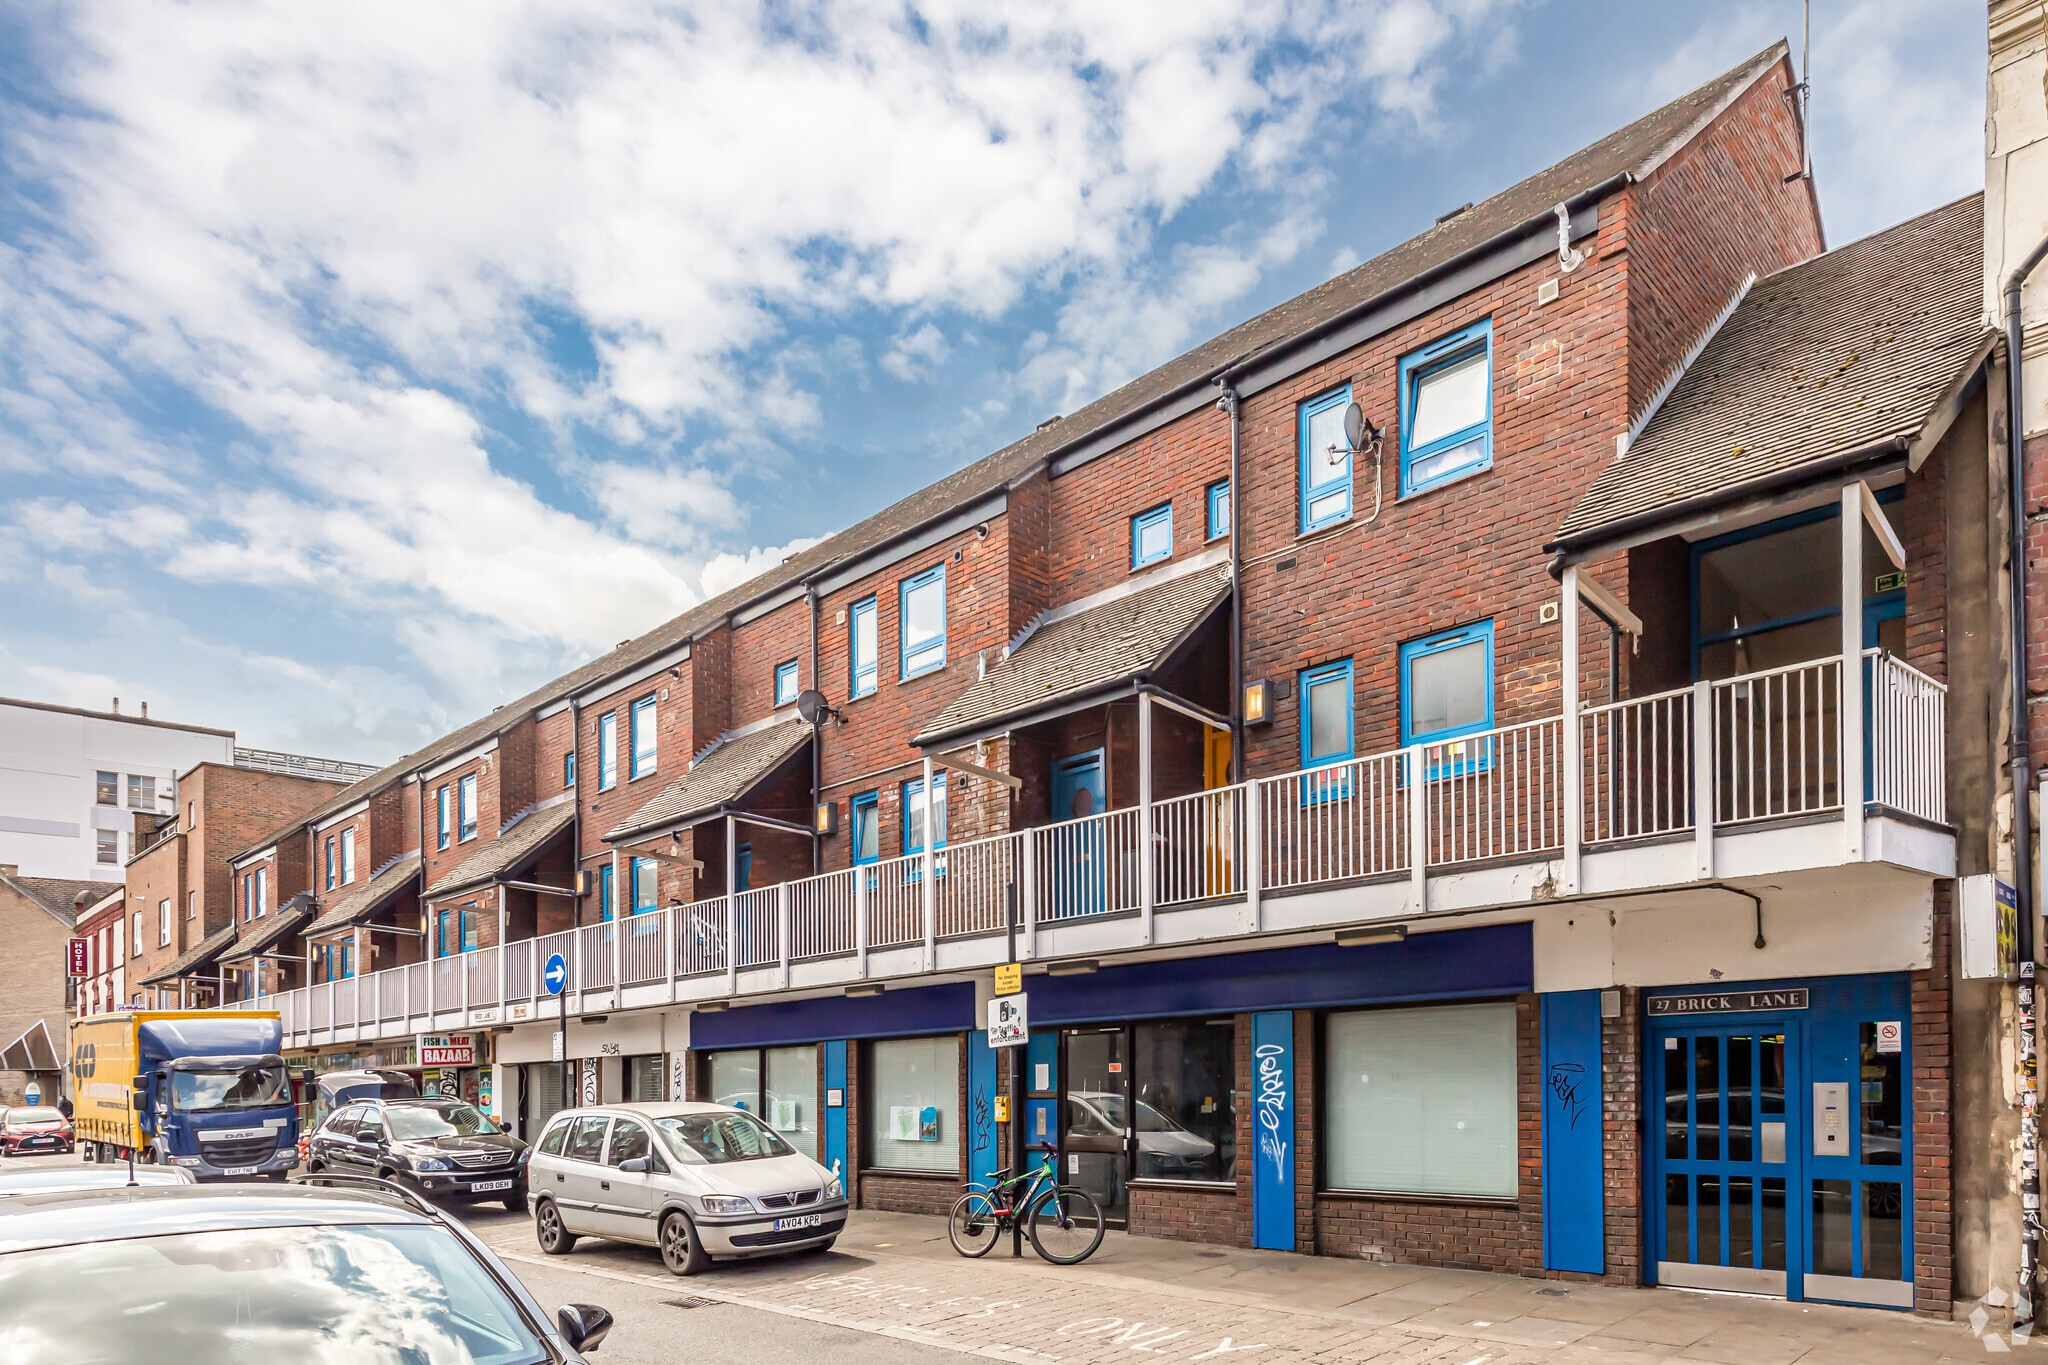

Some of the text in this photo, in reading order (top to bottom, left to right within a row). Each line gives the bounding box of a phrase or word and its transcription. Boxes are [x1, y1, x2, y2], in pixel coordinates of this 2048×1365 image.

[74, 942, 83, 973] HOTEL
[1656, 993, 1800, 1011] 27 BRICK LANE
[423, 1037, 441, 1046] FISH
[449, 1036, 470, 1046] MEAT
[423, 1048, 471, 1063] BAZAAR
[474, 1182, 494, 1191] LK09
[780, 1214, 820, 1229] AV04 KPR
[1055, 1317, 1268, 1360] ONLY
